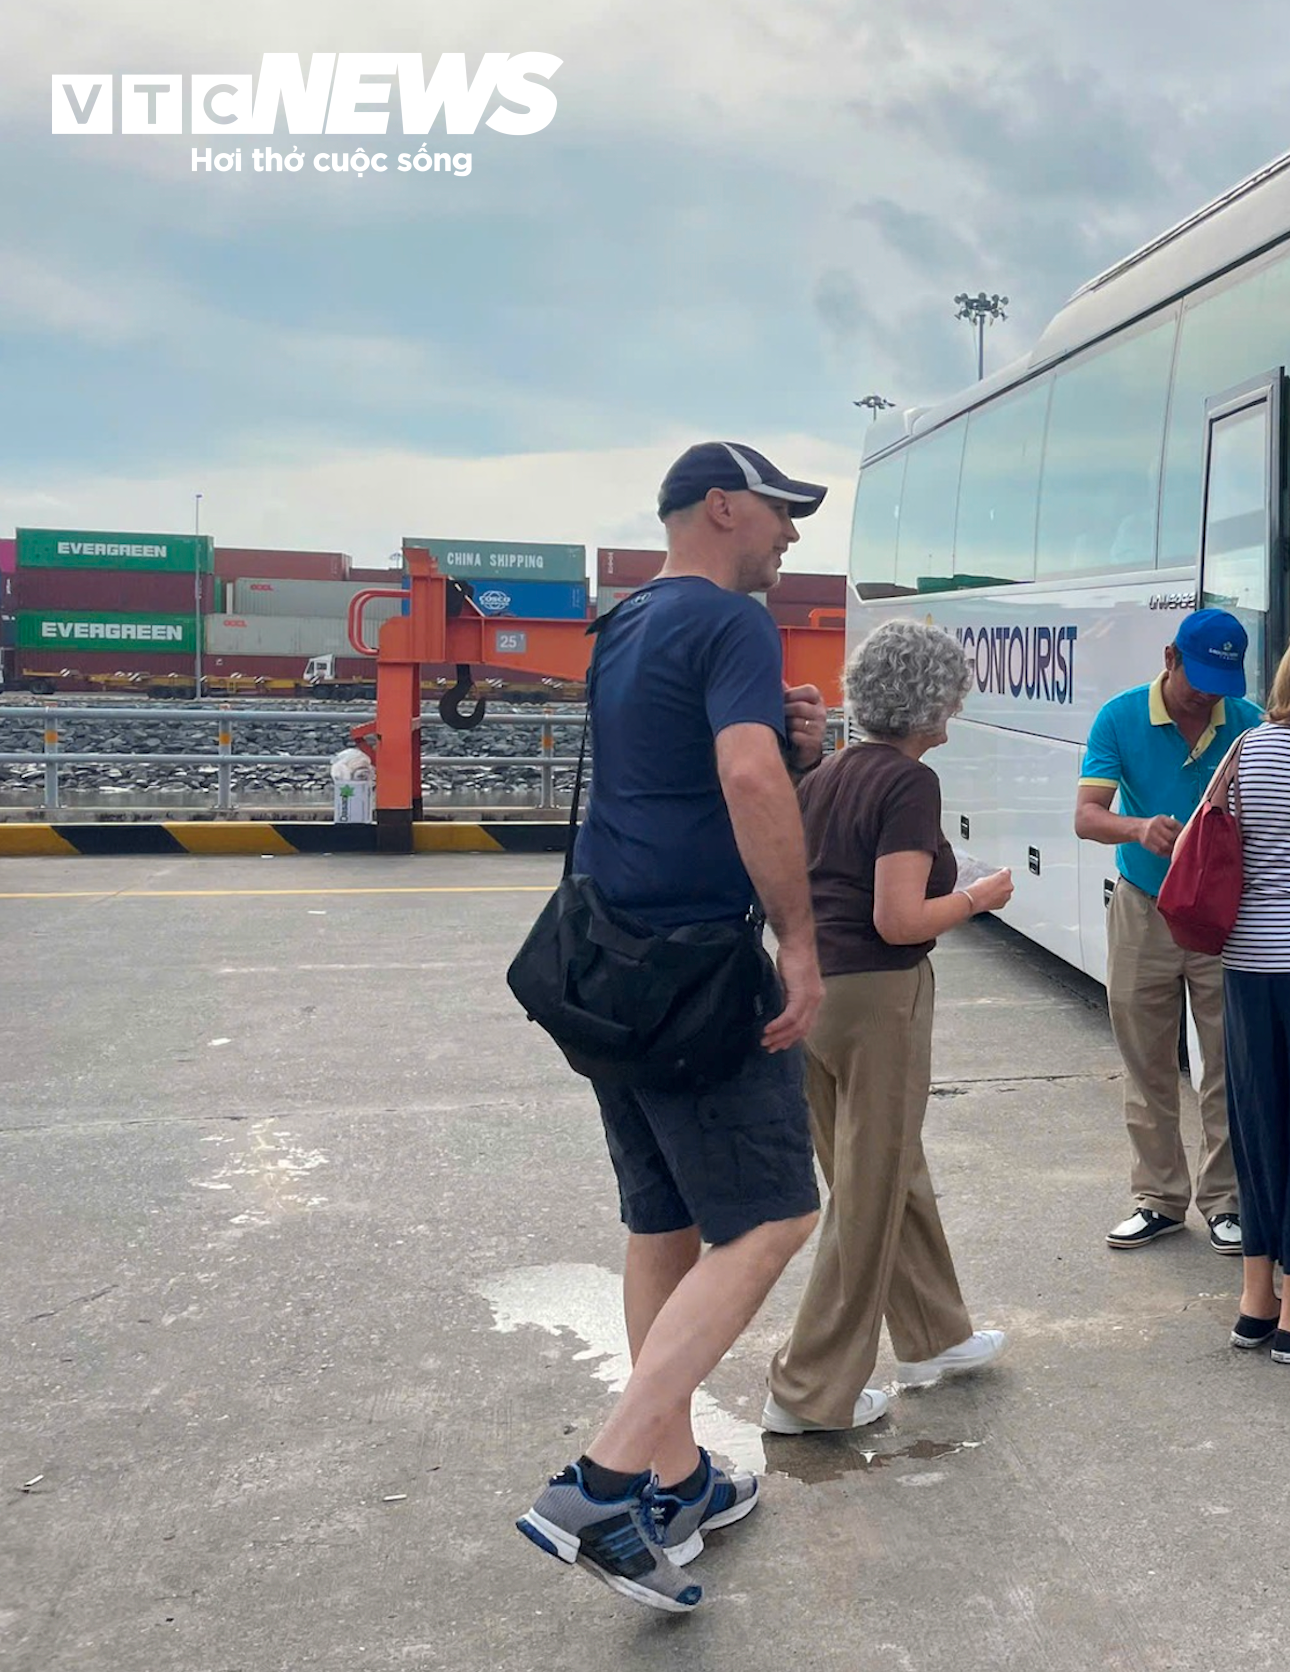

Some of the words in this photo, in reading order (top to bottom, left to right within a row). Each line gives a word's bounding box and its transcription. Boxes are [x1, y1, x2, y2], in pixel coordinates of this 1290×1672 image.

[57, 541, 167, 558] EVERGREEN
[446, 551, 482, 567] CHINA
[489, 553, 544, 569] SHIPPING
[41, 621, 183, 641] EVERGREEN
[500, 635, 517, 648] 25
